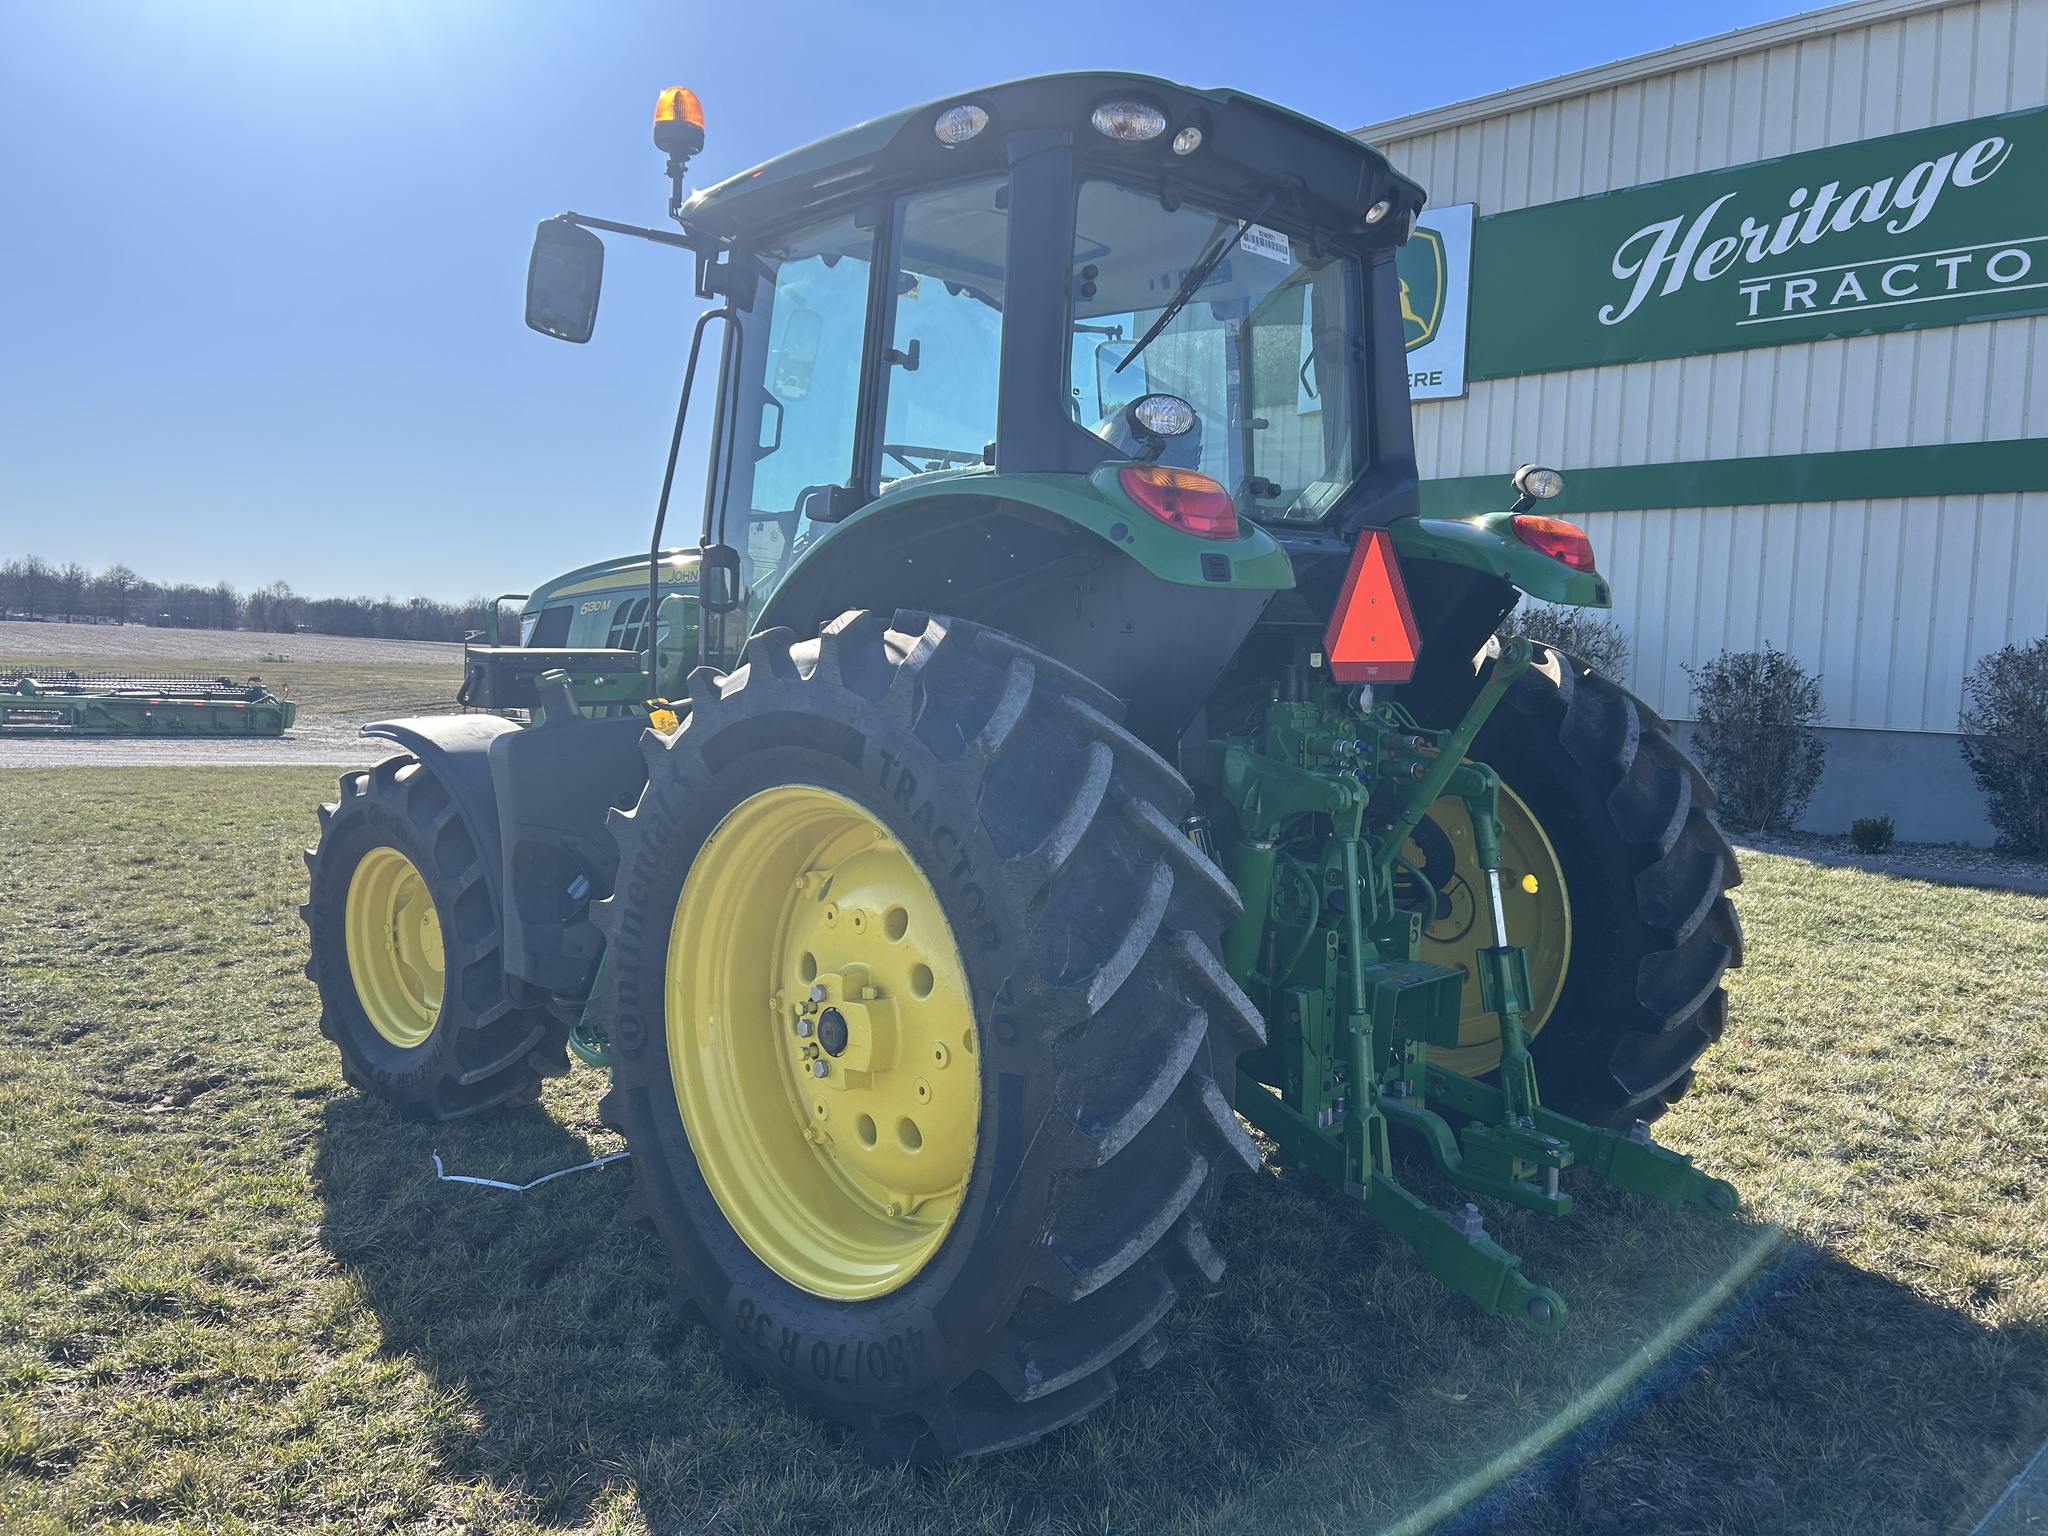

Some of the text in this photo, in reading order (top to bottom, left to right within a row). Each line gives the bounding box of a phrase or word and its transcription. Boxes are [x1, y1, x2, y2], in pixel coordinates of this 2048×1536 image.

[1598, 136, 2014, 326] Heritage
[1739, 248, 2032, 316] TRACTO
[667, 569, 699, 584] JOHN
[878, 749, 1003, 960] TRACTOR
[612, 786, 683, 1060] Continental
[396, 1041, 443, 1090] TRACTOR
[733, 1297, 927, 1386] 480/70 R 38
